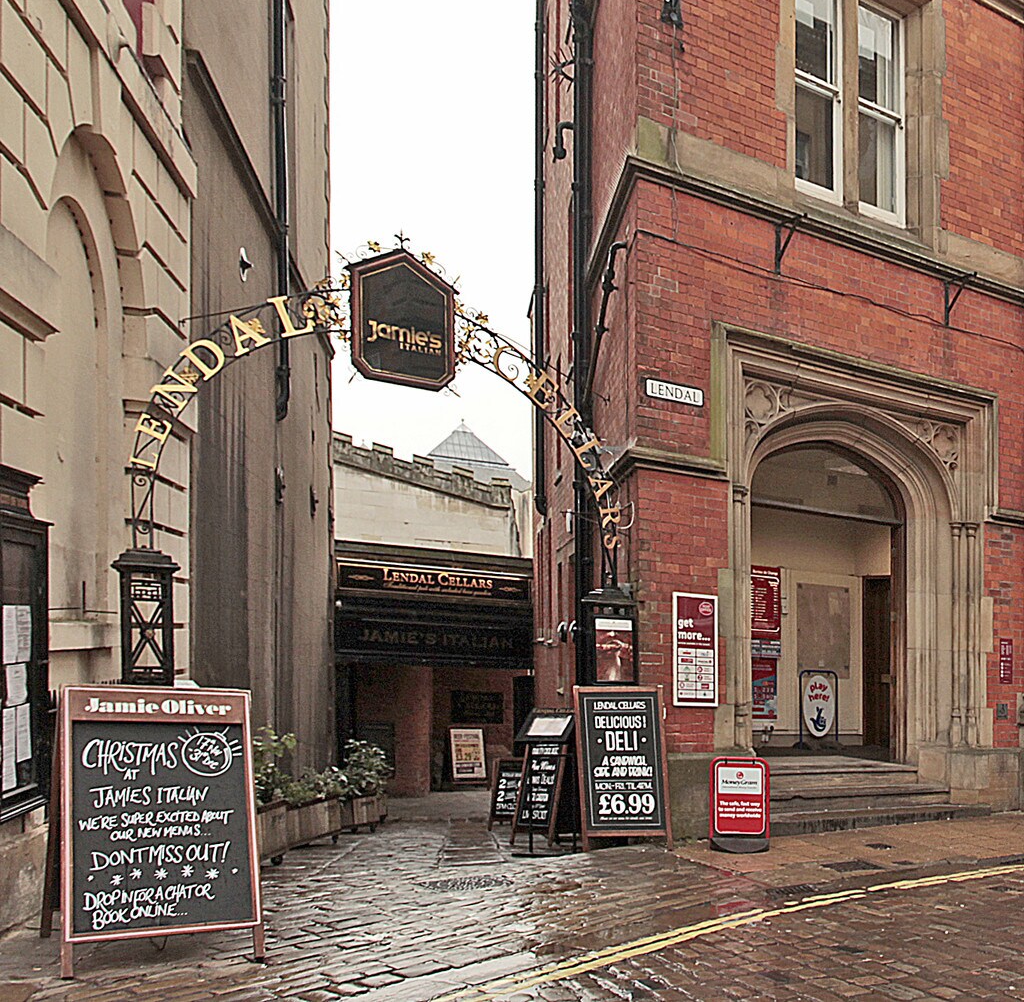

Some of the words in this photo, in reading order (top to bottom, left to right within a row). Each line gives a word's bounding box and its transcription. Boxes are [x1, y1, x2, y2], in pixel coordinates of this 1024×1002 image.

[400, 343, 441, 356] ITALIAN
[650, 383, 700, 403] LENDAL
[129, 296, 315, 470] LENDAL
[493, 346, 621, 549] CELLARS
[383, 567, 435, 585] LENDAL
[437, 571, 493, 589] CELLARS
[678, 618, 693, 629] get
[809, 681, 828, 693] play
[84, 697, 160, 714] Jamie
[160, 699, 232, 716] Oliver
[593, 701, 617, 710] LENDAL
[618, 701, 646, 710] CELLARS
[808, 692, 829, 703] here!
[605, 730, 638, 751] DELI
[82, 739, 178, 775] CHRISTMAS
[602, 756, 609, 766] A
[123, 769, 140, 780] AT
[611, 767, 627, 777] AND
[89, 786, 152, 809] JAMIES
[156, 785, 209, 806] ITALIAN
[598, 793, 655, 815] £6.99
[120, 811, 157, 828] SUPER
[156, 810, 200, 824] EXCITED
[201, 809, 234, 824] ABOUT
[110, 829, 138, 842] OUR
[137, 827, 163, 839] NEW
[148, 845, 183, 866] MISS
[185, 841, 231, 863] OUT!
[82, 887, 121, 912] DROP
[121, 890, 133, 904] IN
[132, 885, 157, 908] FOR
[156, 886, 165, 901] A
[164, 883, 193, 901] CHAT
[194, 883, 215, 901] OR
[92, 907, 131, 930] BOOK
